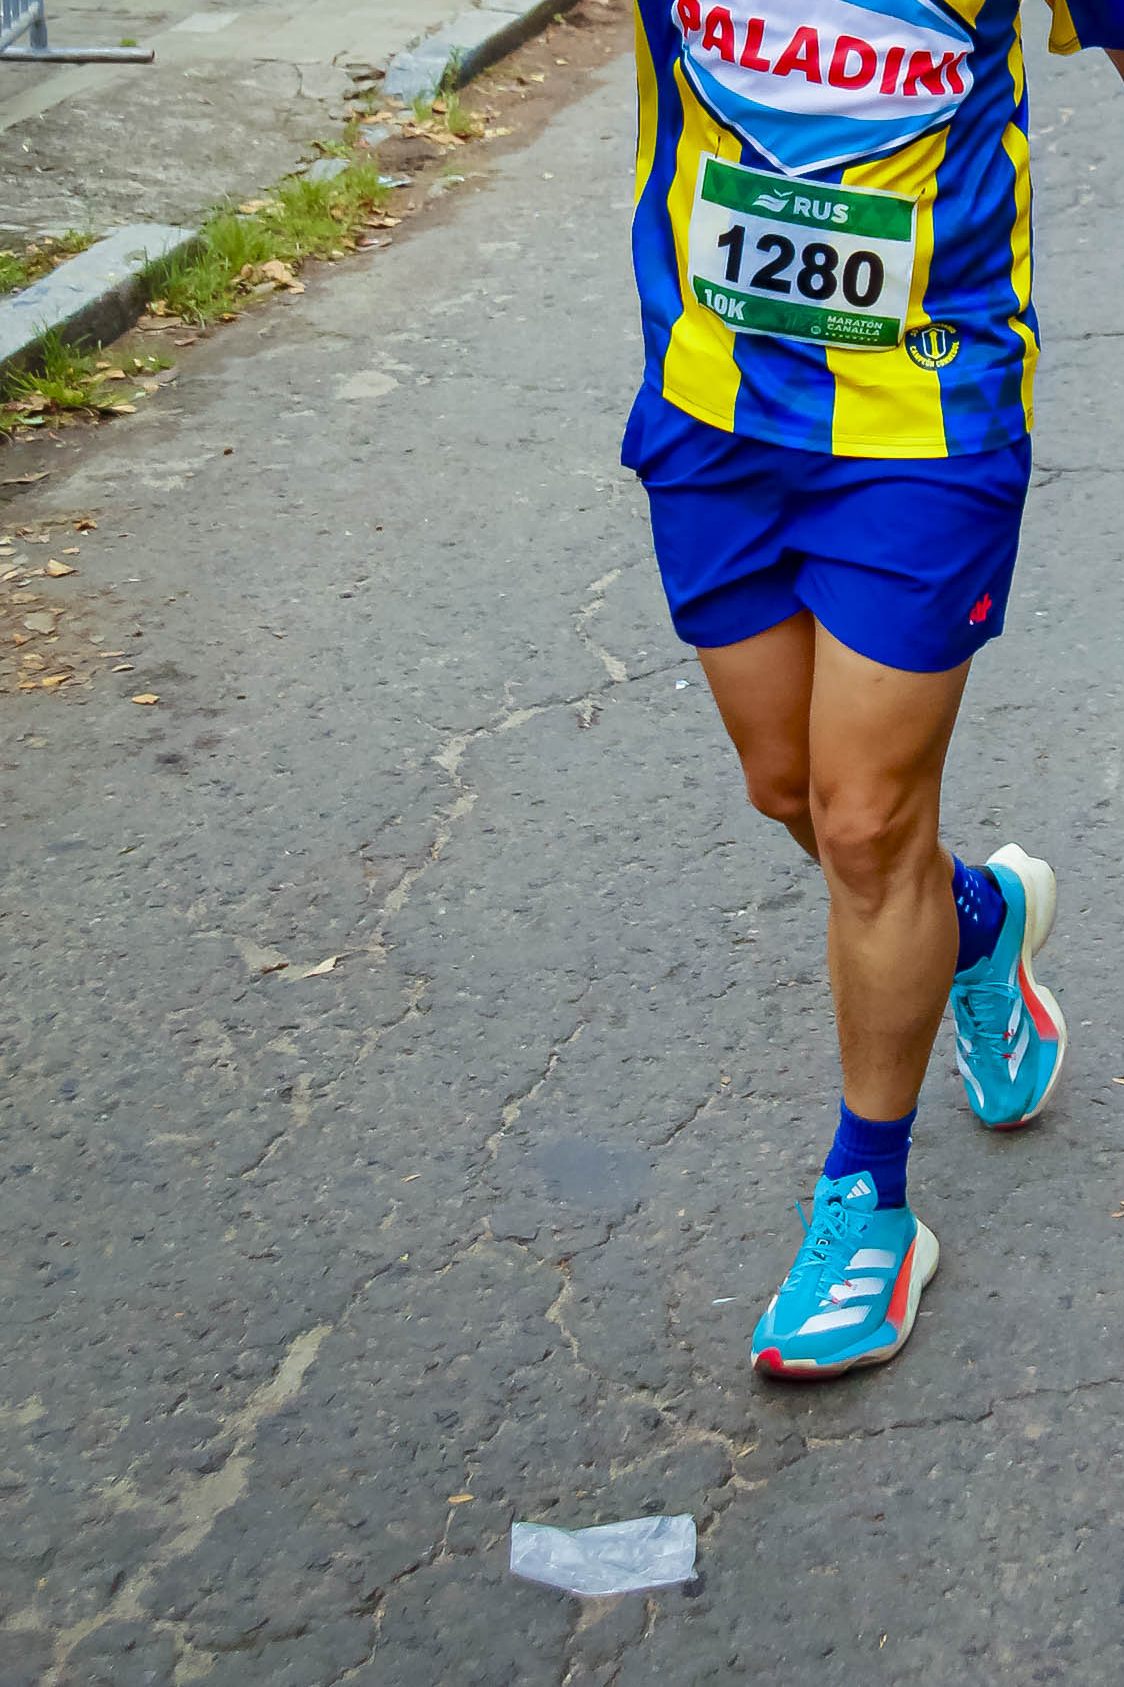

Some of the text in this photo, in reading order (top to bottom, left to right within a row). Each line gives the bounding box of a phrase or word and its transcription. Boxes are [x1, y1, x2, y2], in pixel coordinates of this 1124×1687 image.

[793, 196, 849, 224] RUS
[717, 224, 884, 308] 1280
[704, 288, 747, 321] 10K
[827, 315, 883, 330] MARATÓN
[827, 323, 880, 336] CANALLA
